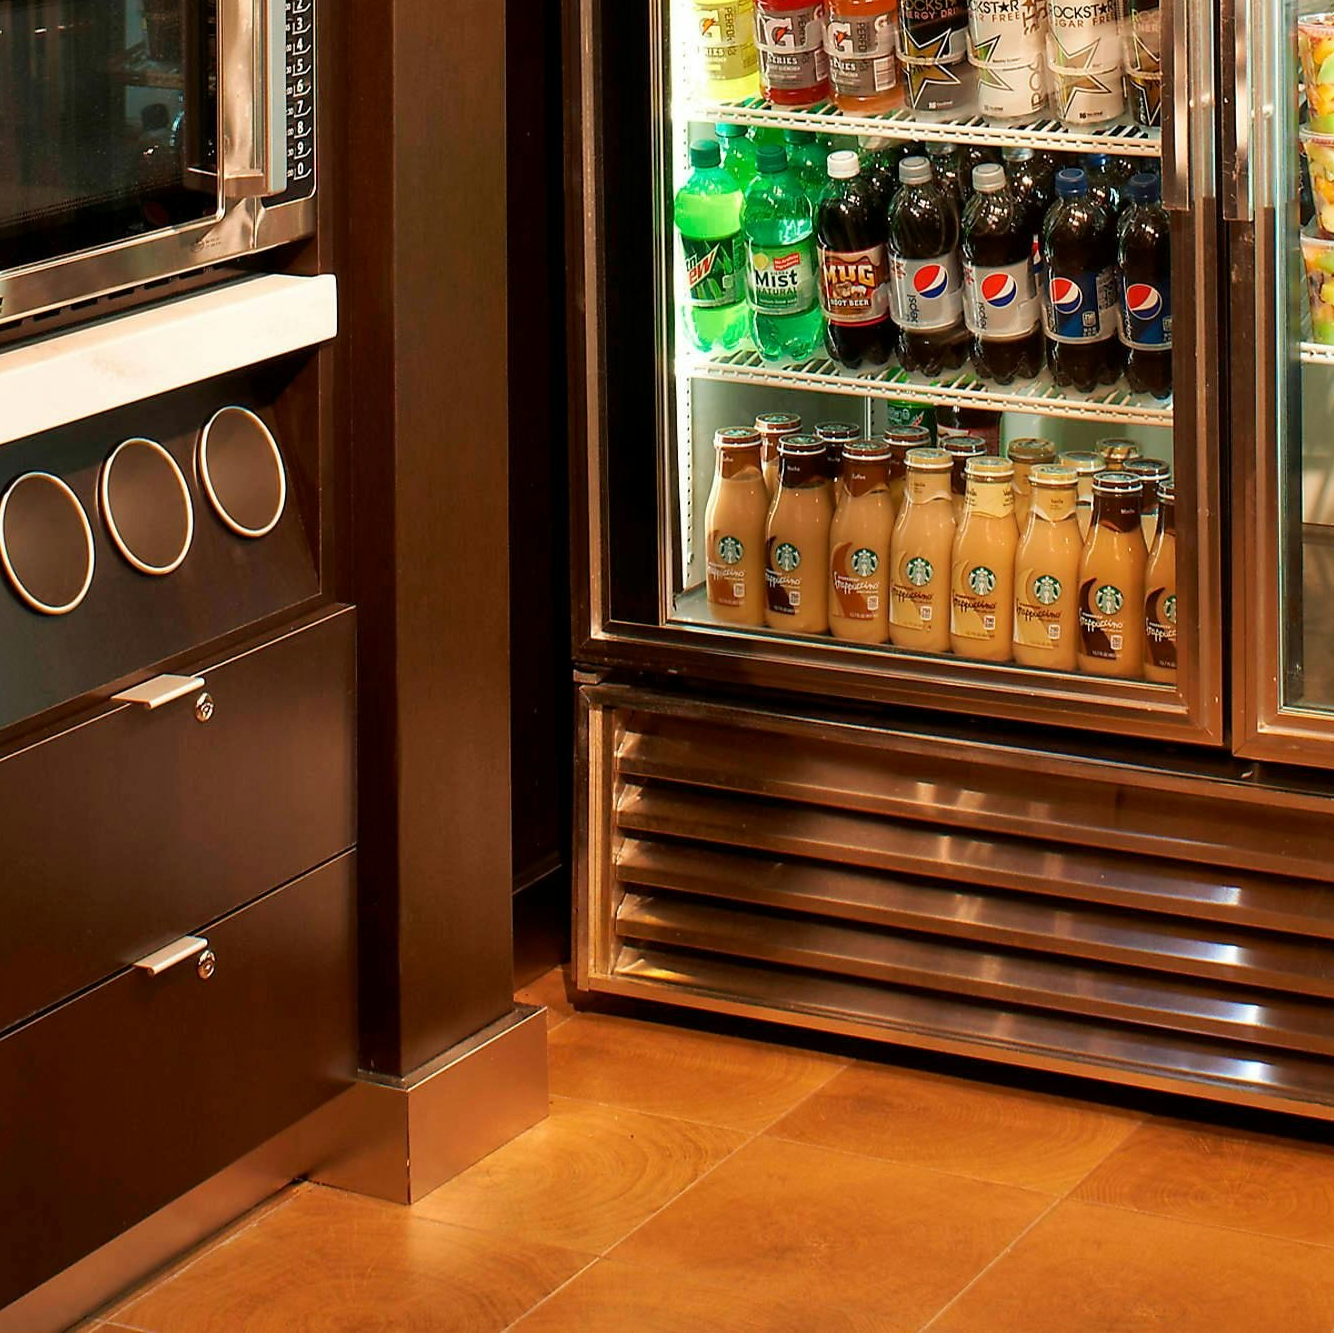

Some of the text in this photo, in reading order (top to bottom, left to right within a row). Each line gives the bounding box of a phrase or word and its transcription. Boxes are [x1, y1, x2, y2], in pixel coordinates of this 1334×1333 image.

[296, 17, 304, 30] 3
[296, 38, 304, 51] 4
[296, 59, 304, 72] 5
[296, 80, 304, 93] 6
[296, 100, 304, 113] 7
[296, 121, 304, 134] 8
[296, 142, 304, 155] 9
[296, 163, 304, 175] 0
[755, 269, 798, 288] Mist
[827, 263, 876, 289] MUG
[849, 298, 869, 307] BEER
